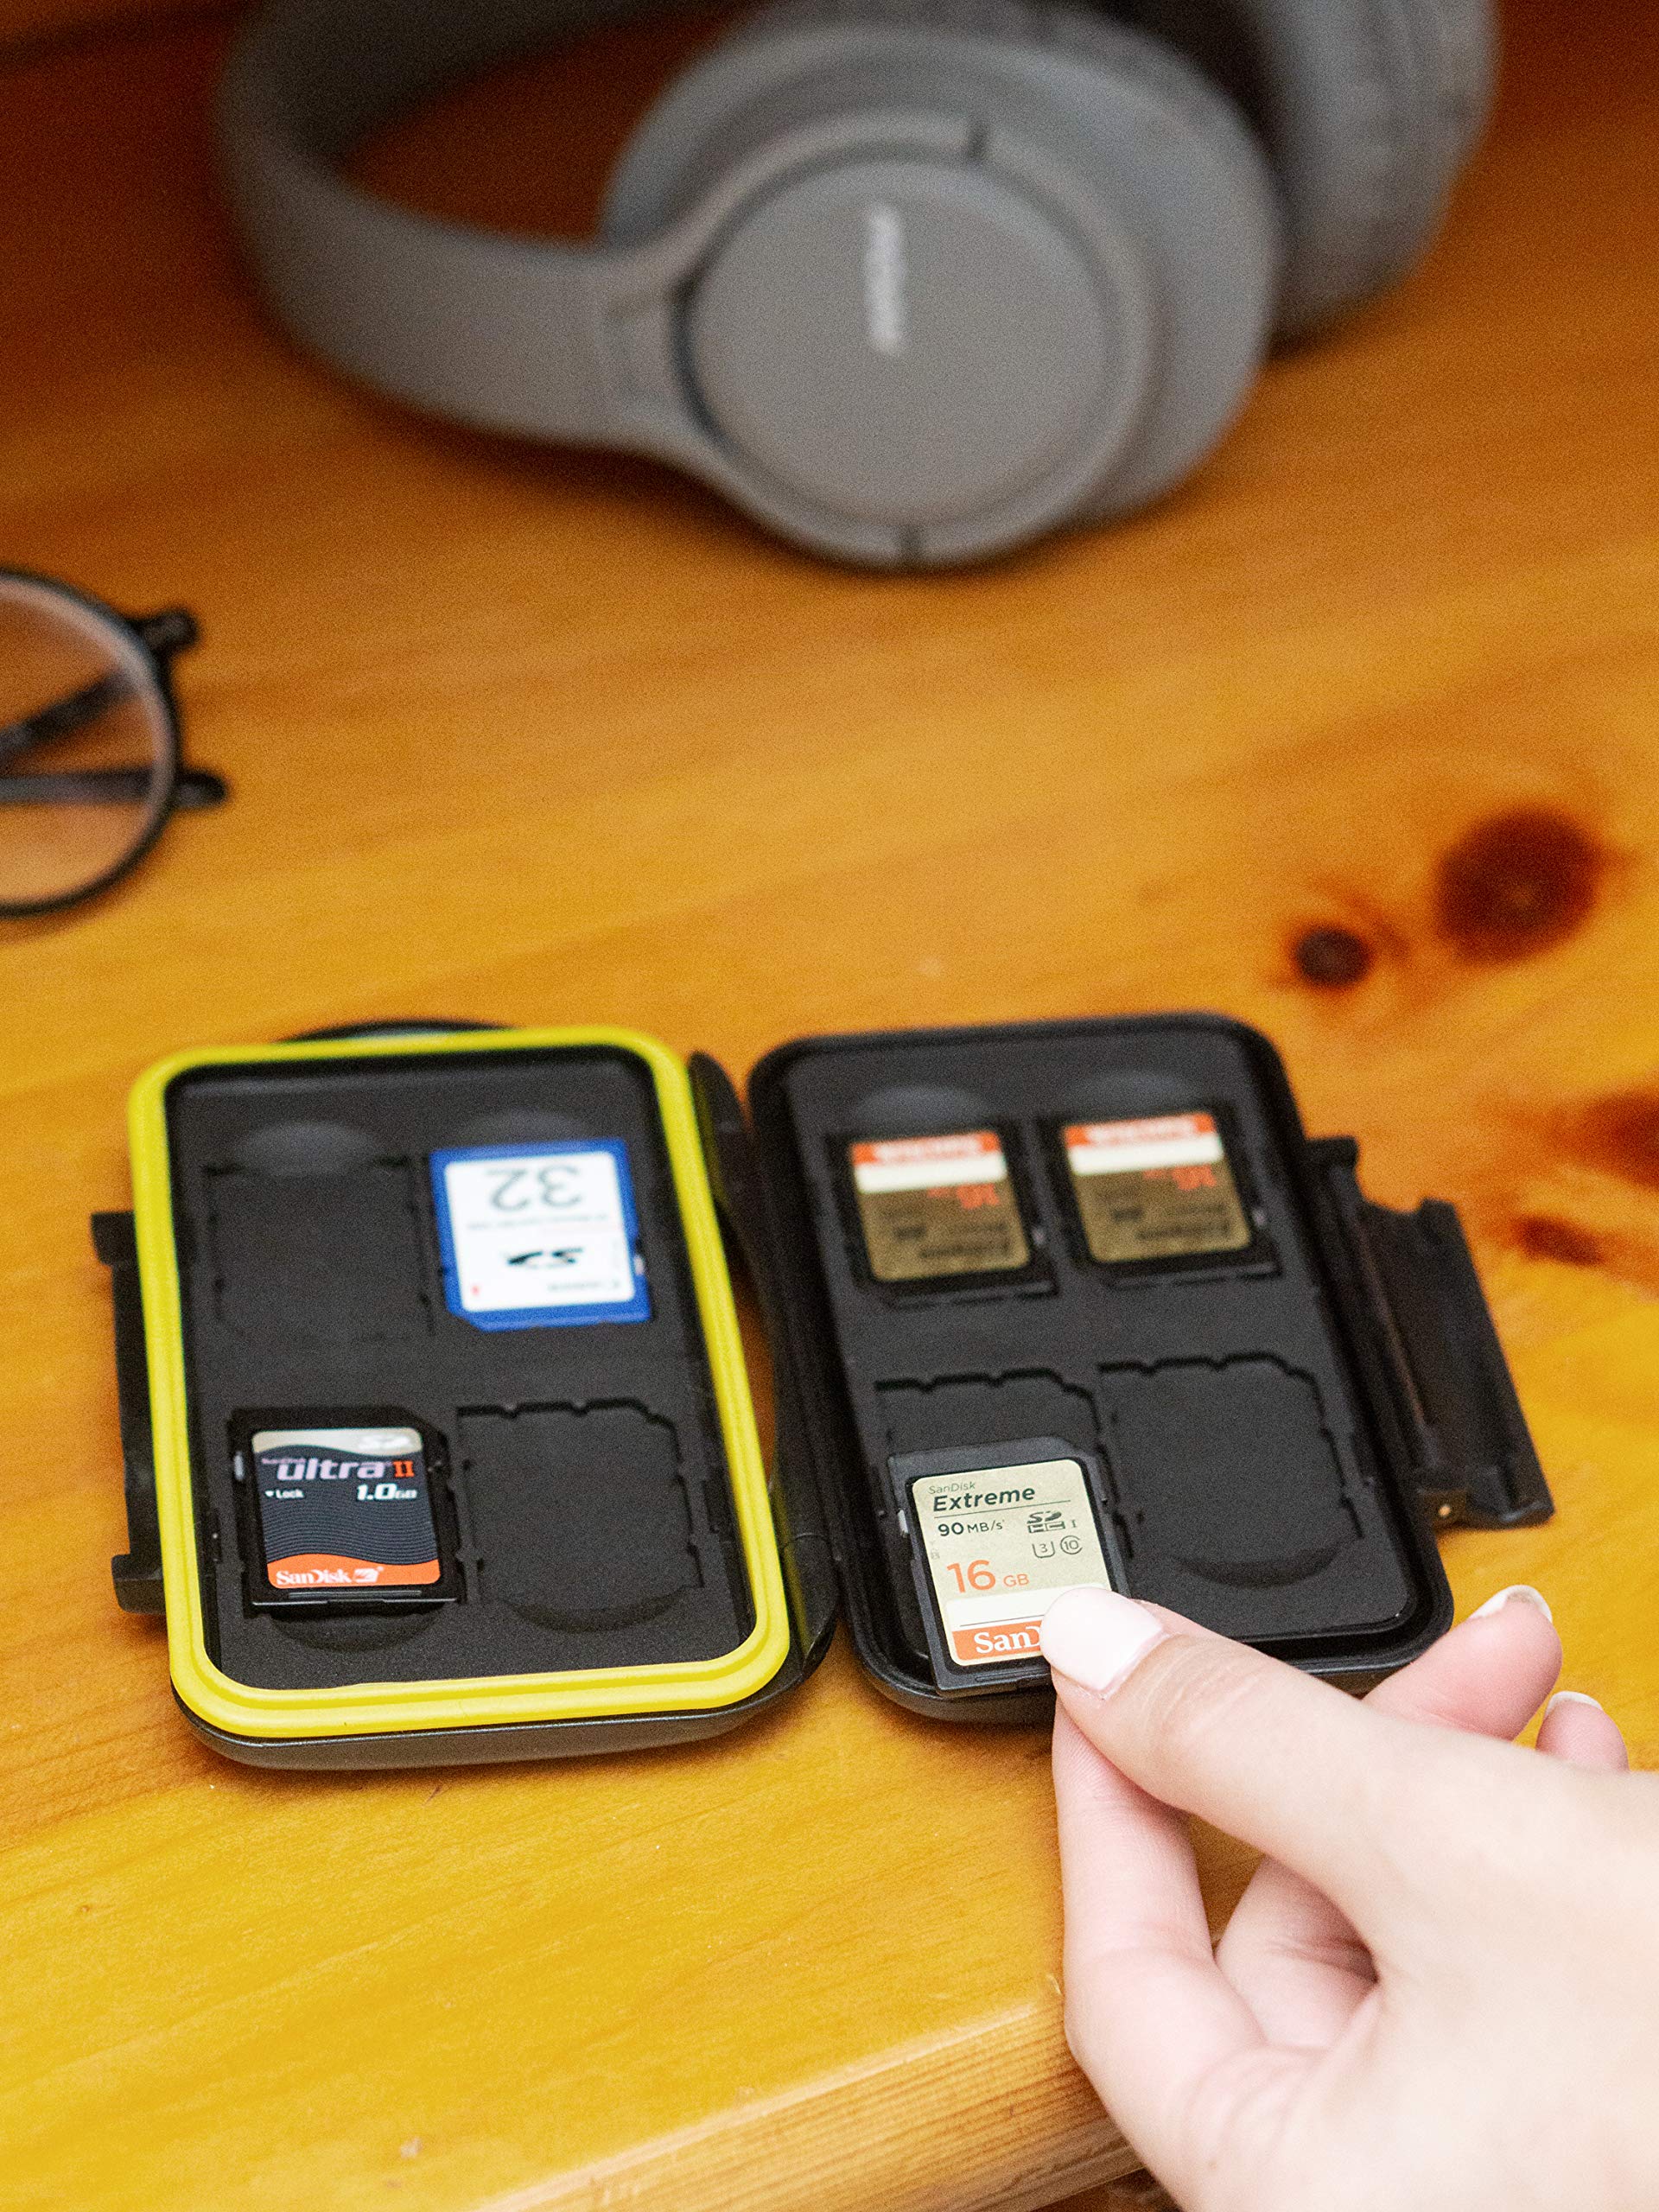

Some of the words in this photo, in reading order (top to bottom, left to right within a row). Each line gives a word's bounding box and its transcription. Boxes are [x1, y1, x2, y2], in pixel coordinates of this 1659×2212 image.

[485, 1165, 583, 1211] 32
[276, 1489, 304, 1498] Lock
[929, 1481, 976, 1495] SanDisk
[933, 1486, 1036, 1512] Extreme
[276, 1568, 353, 1585] SanDisk
[947, 1559, 996, 1593] 16
[1003, 1573, 1030, 1588] GB
[974, 1625, 1040, 1654] SanD
